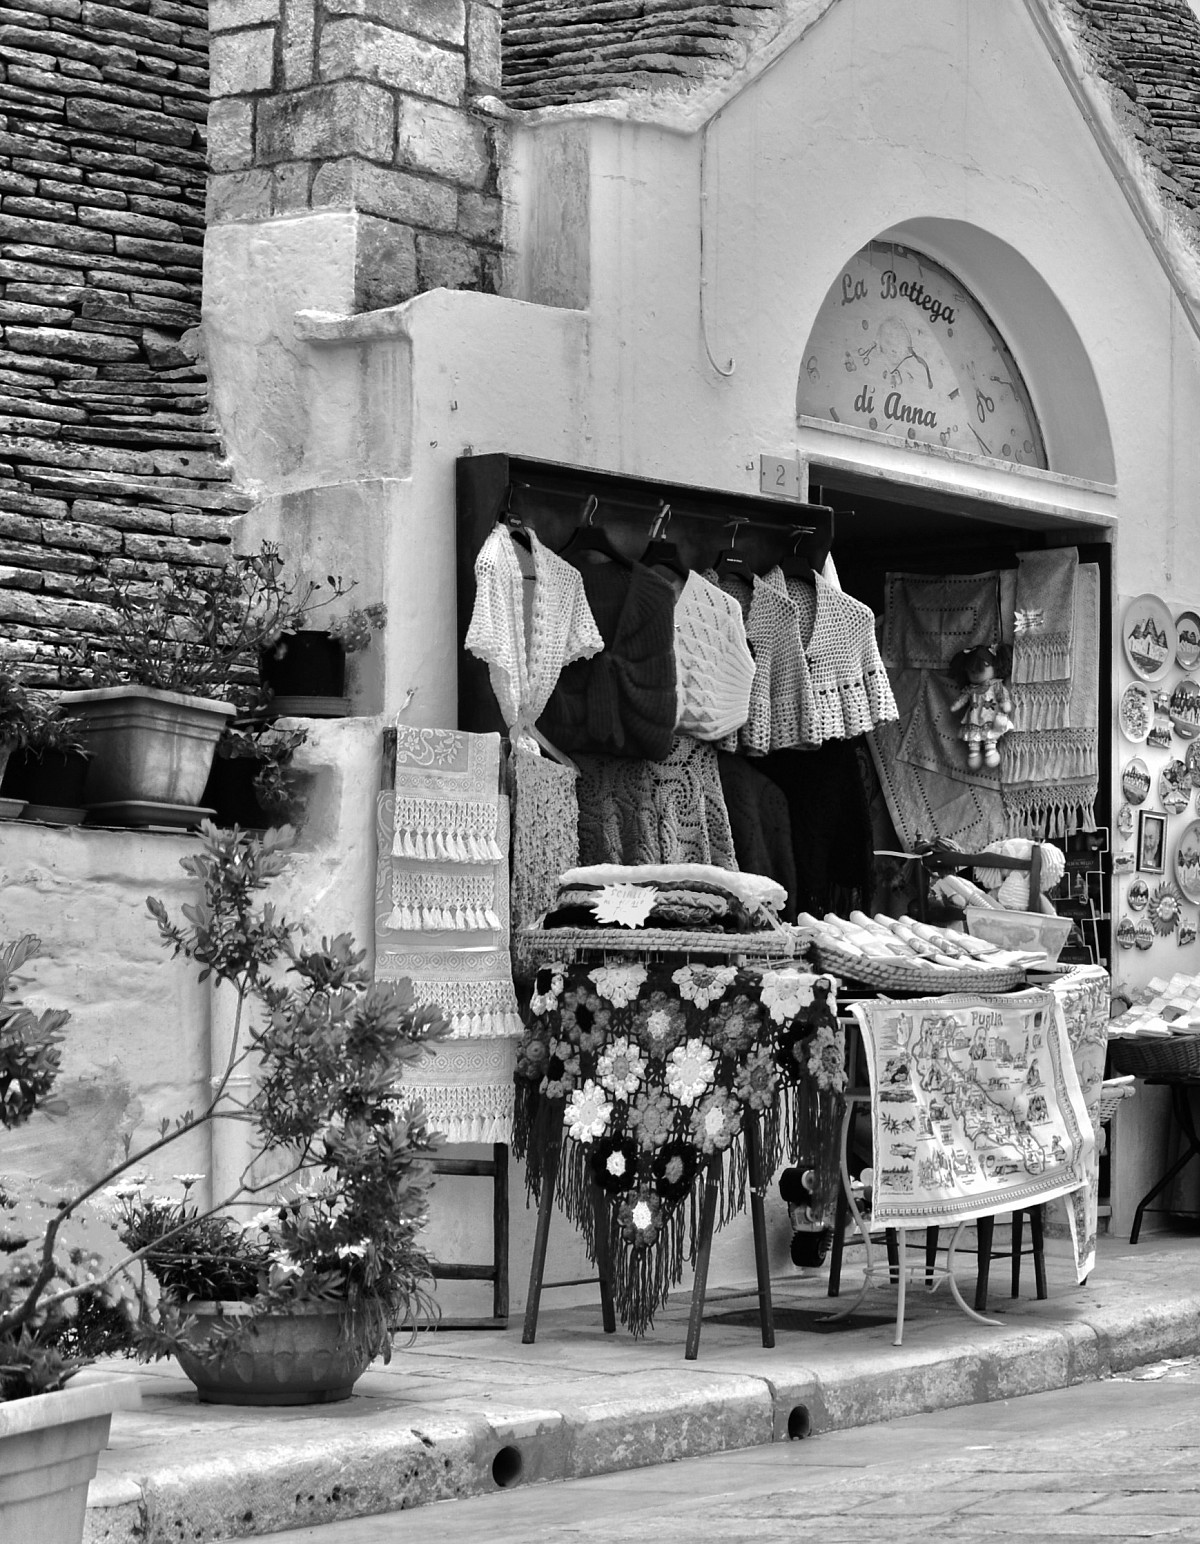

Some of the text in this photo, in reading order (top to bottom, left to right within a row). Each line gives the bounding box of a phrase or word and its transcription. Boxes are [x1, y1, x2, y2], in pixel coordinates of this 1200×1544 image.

[841, 270, 955, 324] La Bottega
[854, 385, 937, 428] di Anna
[776, 464, 785, 486] 2
[971, 1011, 1004, 1031] Puglia
